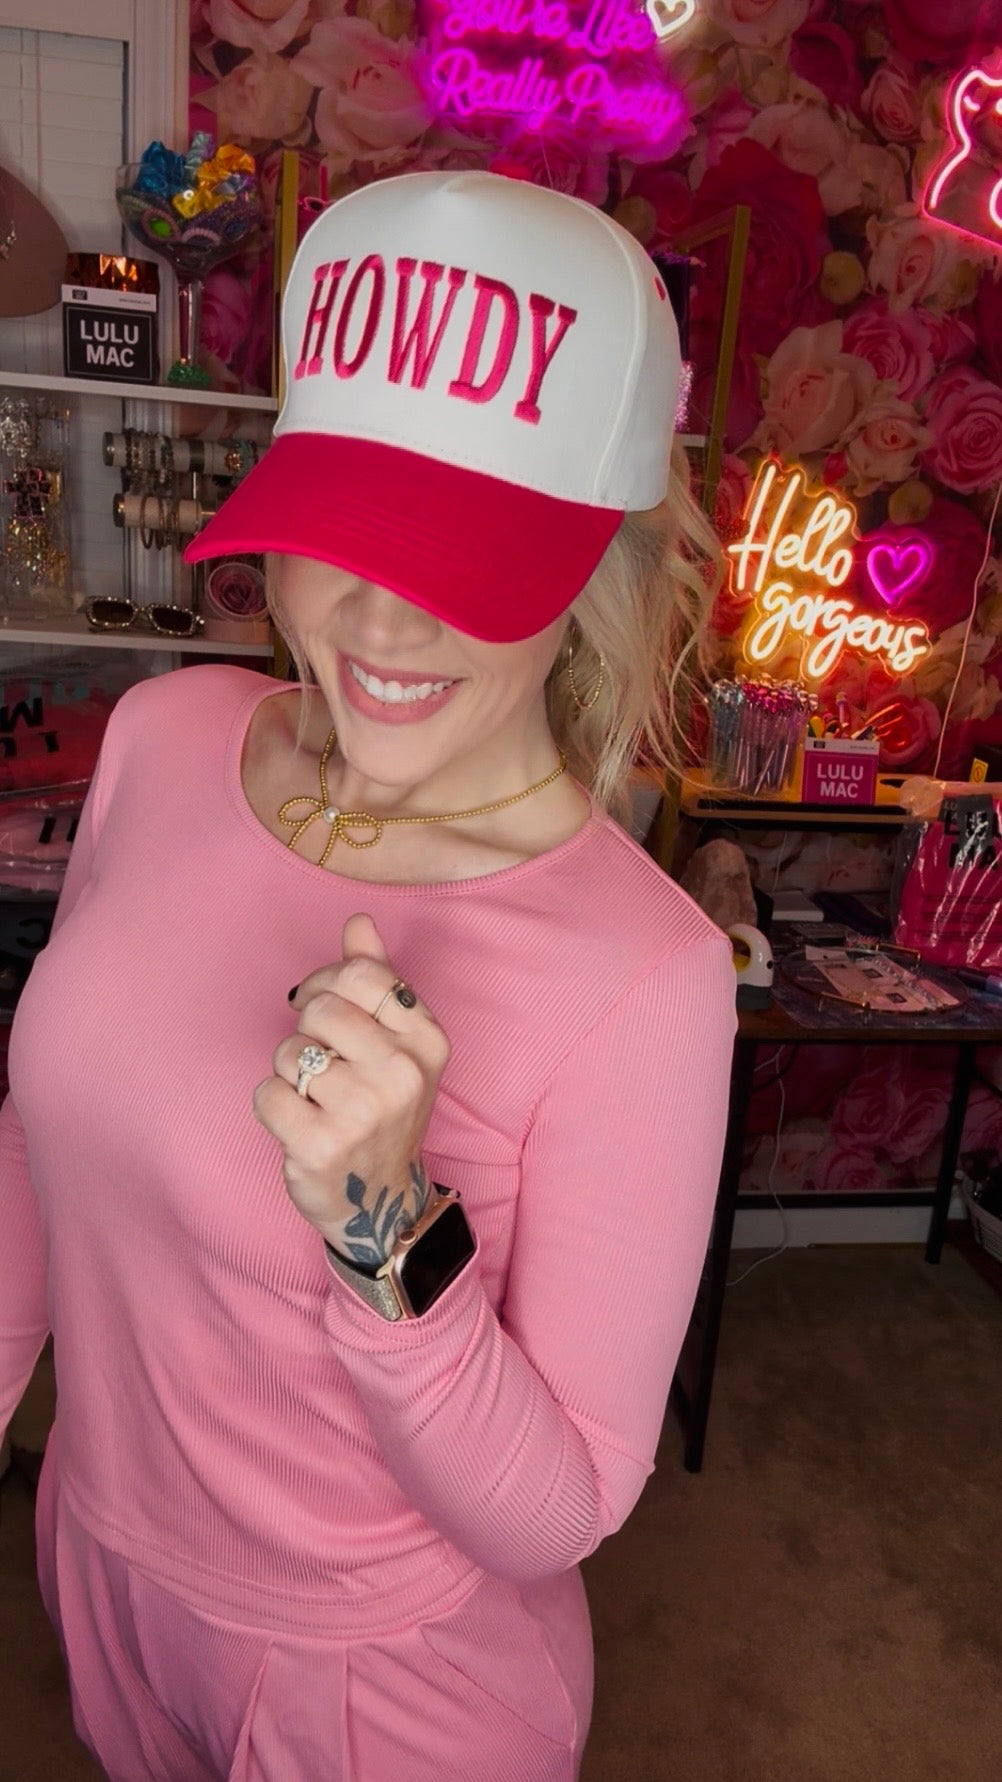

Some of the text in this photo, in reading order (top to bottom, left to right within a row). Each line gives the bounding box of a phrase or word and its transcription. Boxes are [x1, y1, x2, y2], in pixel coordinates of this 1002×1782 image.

[432, 48, 685, 143] Really Pretty
[79, 319, 140, 346] LULU
[86, 344, 136, 368] MAC
[295, 253, 579, 426] HOWDY
[727, 464, 854, 593] Hello
[750, 582, 928, 677] gorgeous
[816, 762, 865, 782] LULU
[819, 781, 860, 799] MAC
